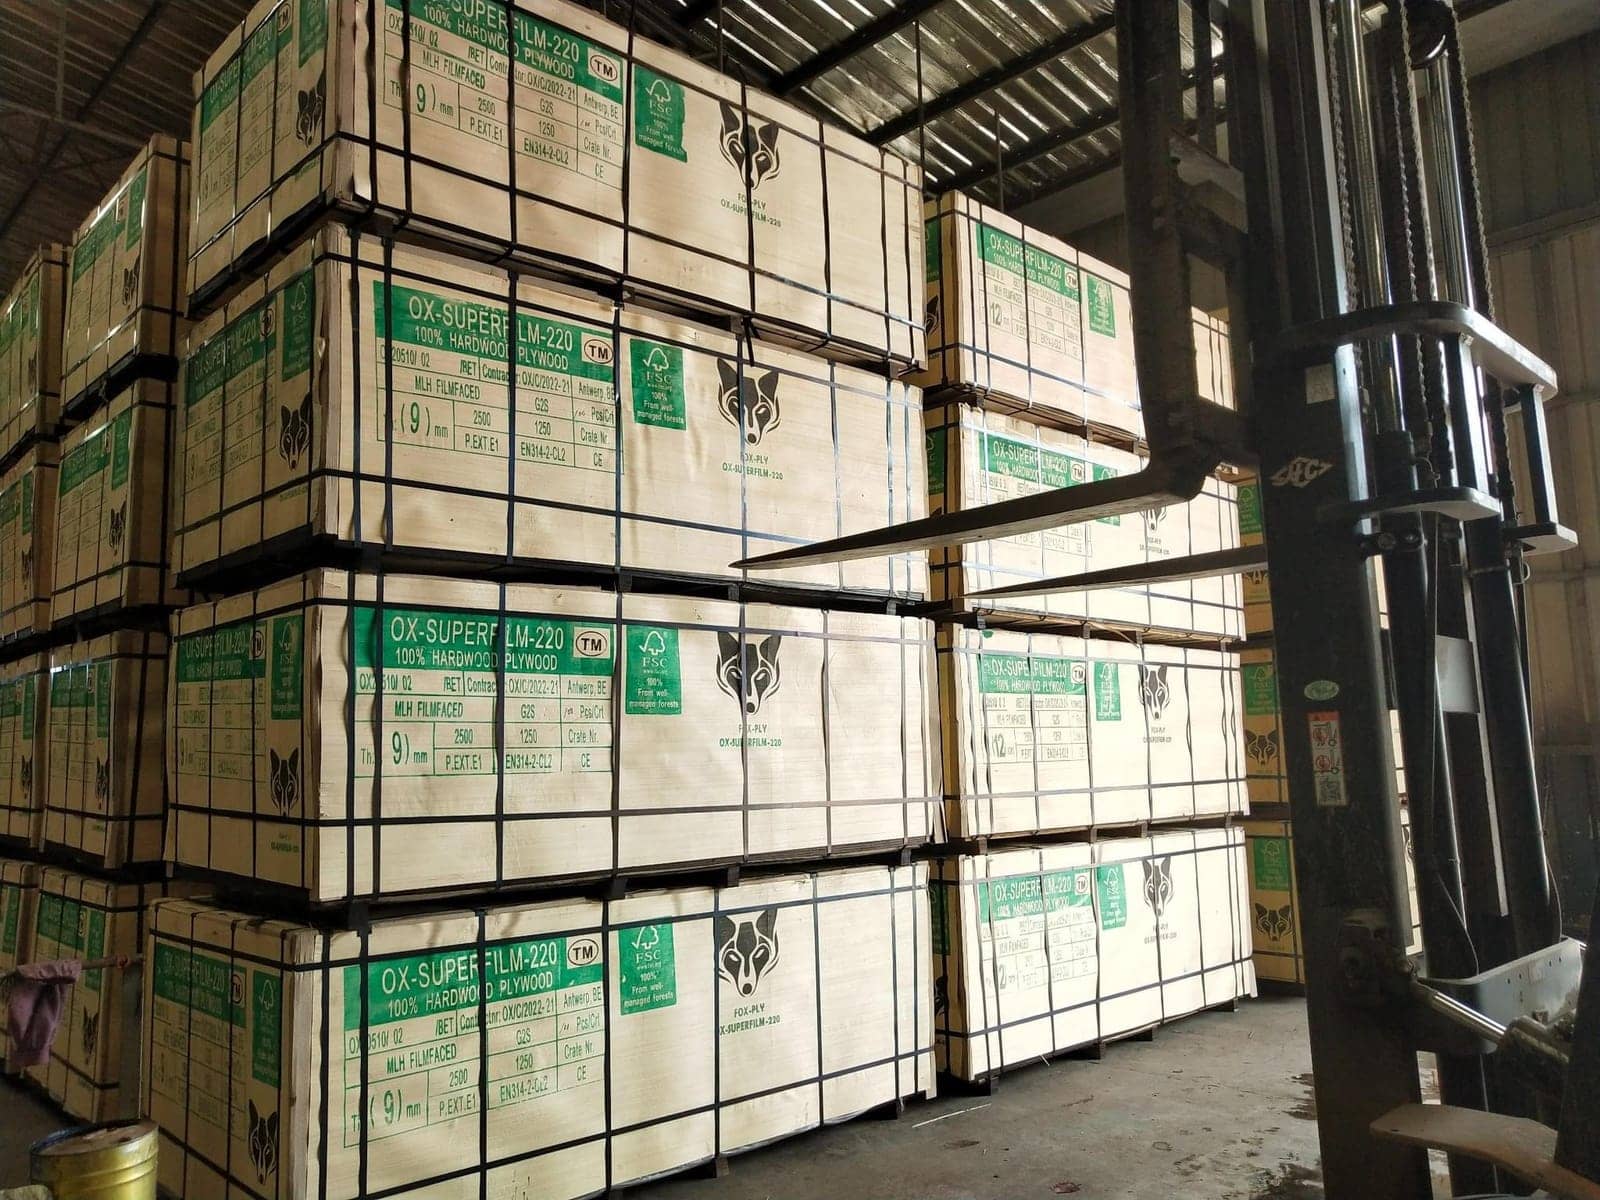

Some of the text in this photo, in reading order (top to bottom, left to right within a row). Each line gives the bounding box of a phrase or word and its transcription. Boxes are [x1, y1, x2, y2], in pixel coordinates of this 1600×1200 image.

[424, 3, 452, 30] 100%
[524, 47, 575, 80] PLYWOOD
[422, 50, 486, 90] MLH FILMFACED
[594, 59, 614, 79] TM
[537, 119, 556, 138] 1250
[523, 137, 570, 166] EN314-2-CL2
[737, 192, 766, 210] FO-PLY
[408, 295, 573, 352] OX-SUPERFLM-220
[415, 325, 443, 347] 100%
[518, 346, 569, 371] PLYWOOD
[588, 344, 609, 360] TM
[421, 352, 430, 369] 02
[415, 375, 480, 401] MLH FILMFACED
[473, 409, 492, 428] 2500
[534, 419, 552, 437] 1250
[580, 425, 598, 443] Crate
[520, 441, 566, 463] EN314-2-CL2
[593, 451, 603, 468] CE
[992, 440, 1068, 474] OX-SUPERFLM-220
[721, 461, 784, 481] OX-SUERFILM-220
[390, 616, 564, 650] OX-SUPERFLM-220
[580, 637, 602, 652] TM
[396, 647, 558, 671] 100% HARDWOOD PLYWOOD
[642, 656, 668, 668] FSC
[991, 657, 1067, 679] OX-SUPEFILM-220
[402, 674, 412, 691] 02
[394, 700, 464, 718] MLH FILMFACED
[520, 703, 536, 719] G2S
[454, 728, 474, 745] 2500
[519, 729, 538, 744] 1250
[568, 729, 587, 744] Crate
[738, 723, 767, 734] FX-PLY
[719, 738, 782, 748] OX-SURFILM-220
[413, 750, 428, 763] mm
[505, 752, 553, 770] EN314-2-CL2
[580, 753, 591, 769] CE
[994, 875, 1072, 902] OX-SUPERFLM-220
[572, 947, 593, 962] TM
[635, 949, 661, 964] FSC
[388, 996, 418, 1018] 100%
[500, 971, 553, 996] PLYWOOD
[733, 1002, 765, 1018] FOX-PLY
[719, 1014, 781, 1036] X-SUPERFILM-220
[393, 1027, 403, 1045] 02
[516, 1027, 532, 1045] G2S
[386, 1043, 458, 1074] MLH FILMFACED
[564, 1042, 583, 1060] Crate
[514, 1057, 534, 1076] 1250
[576, 1064, 587, 1082] CE
[449, 1067, 469, 1088] 2500
[500, 1074, 548, 1102] EN314-2-CL2
[406, 1102, 421, 1119] mm
[439, 1093, 477, 1117] P.EXT.E1
